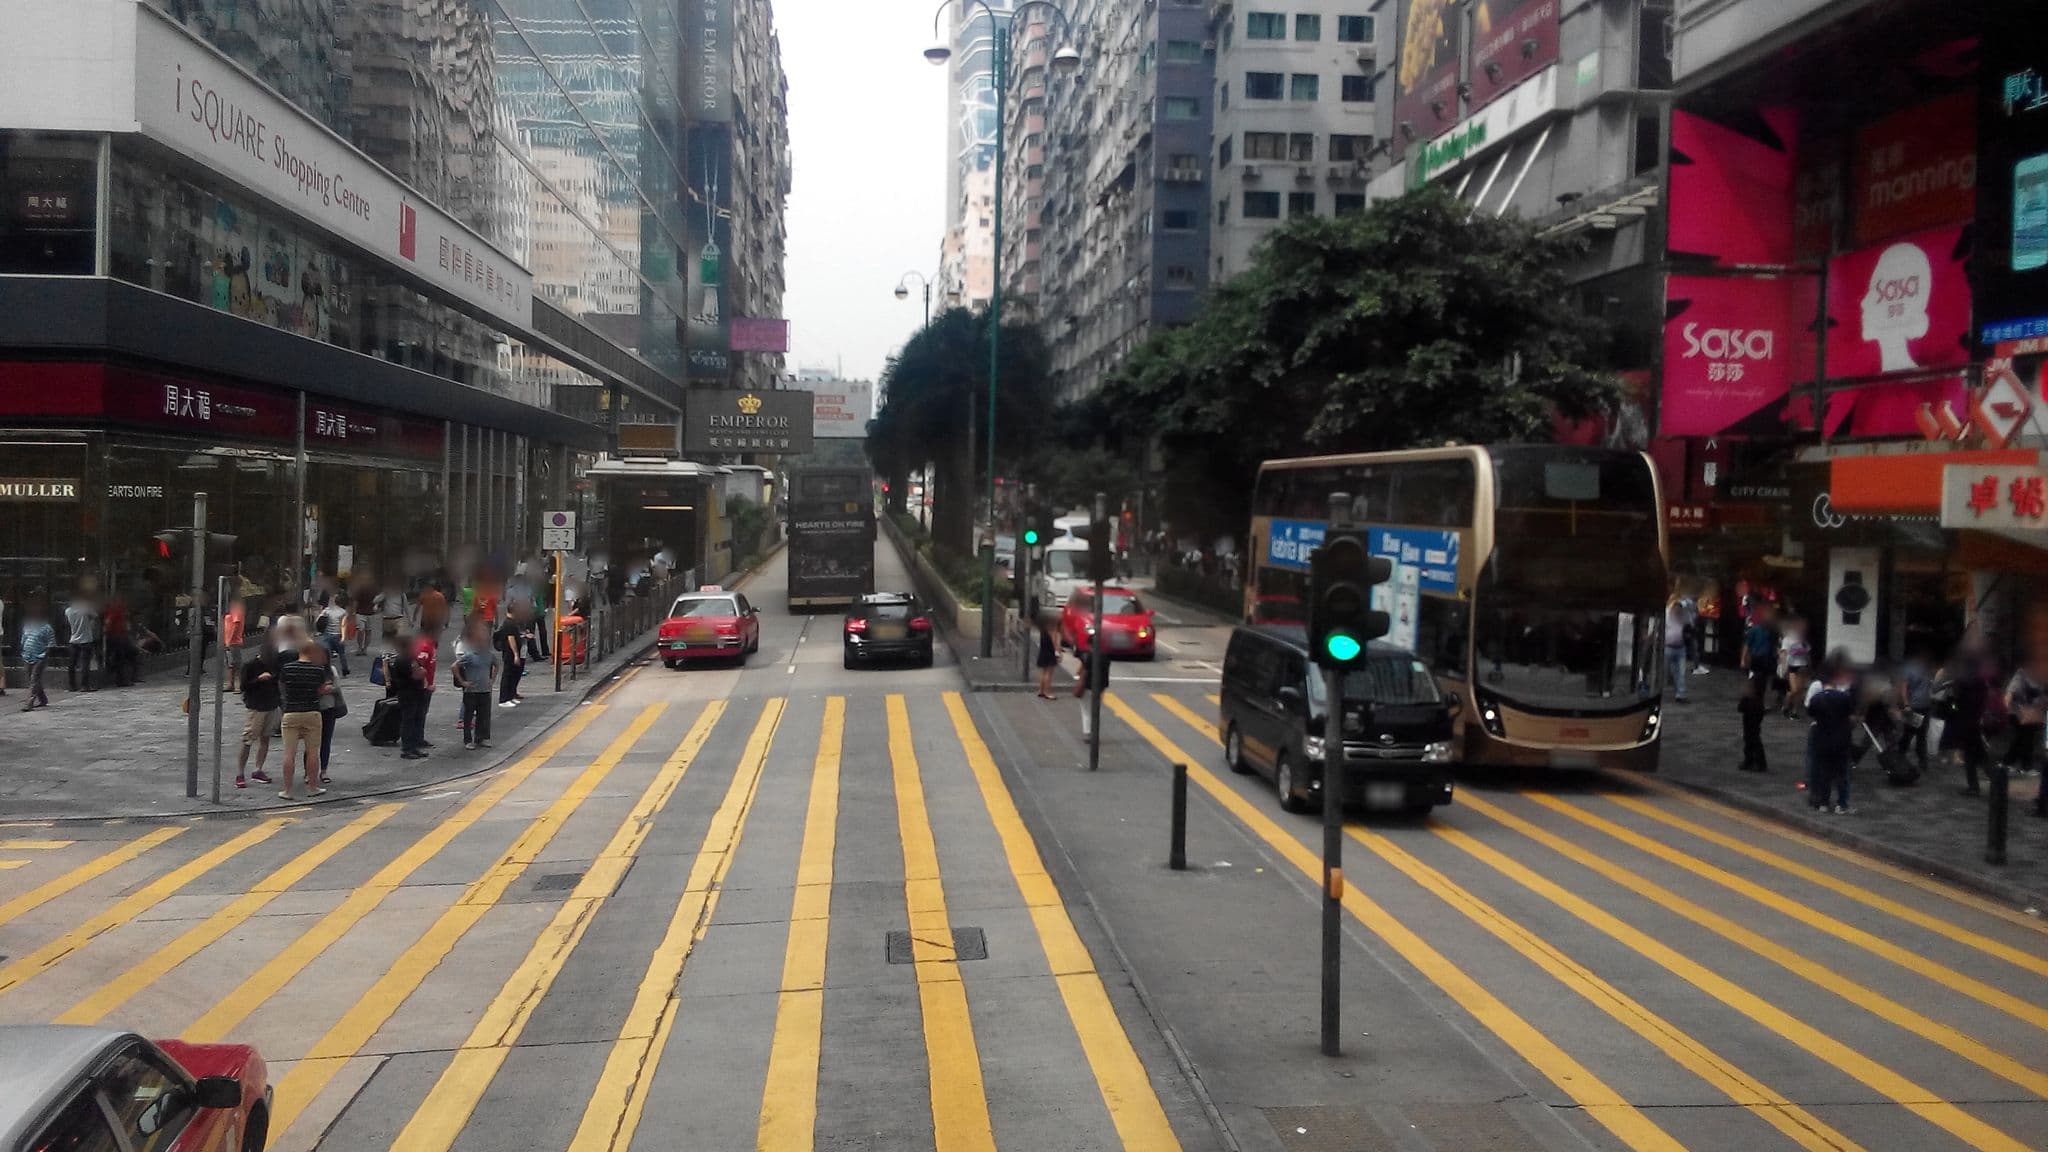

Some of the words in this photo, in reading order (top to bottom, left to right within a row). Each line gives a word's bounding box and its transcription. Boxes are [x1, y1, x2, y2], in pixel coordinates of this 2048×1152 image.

[704, 28, 717, 110] EMPEROR
[190, 79, 266, 162] SQUARE
[274, 134, 330, 206] Shopping
[333, 174, 370, 221] Centre
[164, 385, 211, 420] 周大福
[315, 411, 347, 438] 周大福
[710, 415, 788, 428] EMPEROR
[0, 484, 74, 497] MULLER
[135, 486, 146, 498] ON
[147, 486, 163, 498] FIRE
[795, 521, 831, 529] HEARTS
